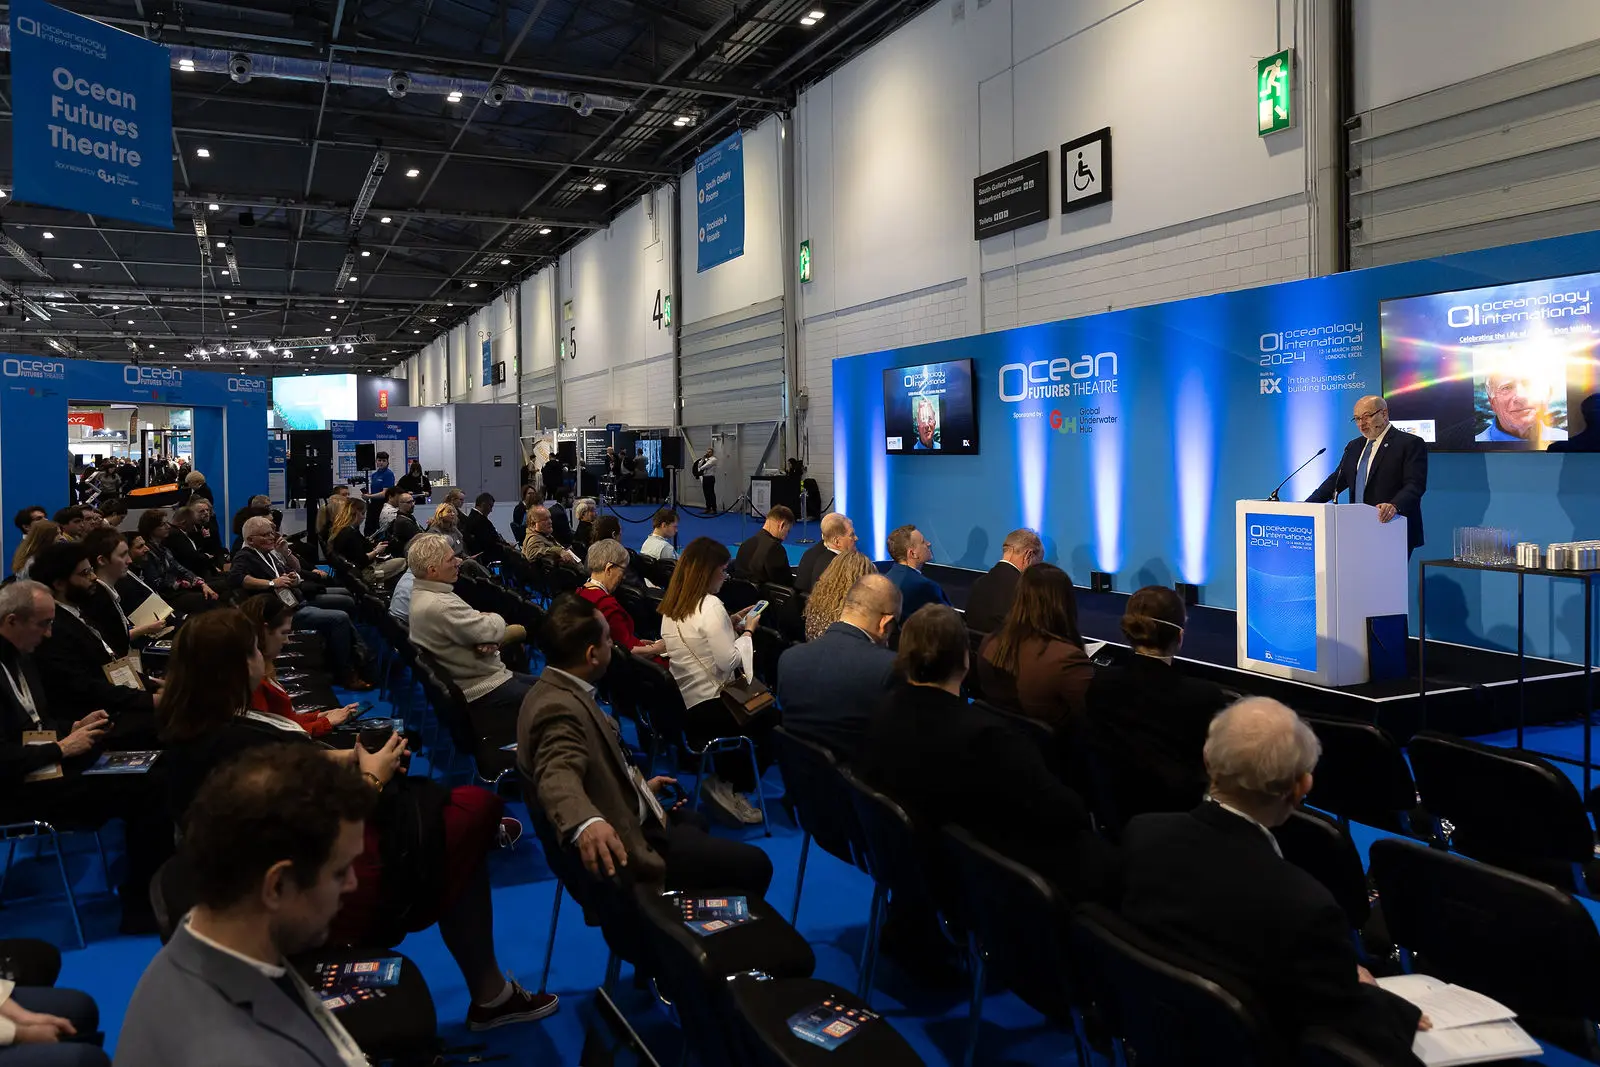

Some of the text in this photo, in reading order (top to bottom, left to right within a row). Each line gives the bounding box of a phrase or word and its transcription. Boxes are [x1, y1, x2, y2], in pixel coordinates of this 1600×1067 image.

[41, 24, 107, 52] oceanology
[41, 32, 107, 60] international
[52, 68, 137, 111] Ocean
[51, 95, 139, 140] Futures
[47, 125, 142, 167] Theatre
[1007, 175, 1024, 185] Rooms
[1002, 187, 1022, 197] Entrance
[979, 217, 993, 225] Toilets
[1481, 290, 1590, 312] oceanology
[652, 290, 663, 331] 4
[1481, 302, 1591, 326] international
[1285, 322, 1363, 339] oceanology
[1459, 333, 1495, 344] Celebrating
[1495, 332, 1506, 340] the
[570, 327, 577, 360] 5
[1284, 333, 1363, 350] international
[3, 359, 65, 377] Ocean
[1260, 352, 1306, 367] 2024
[123, 365, 182, 385] Ocean
[998, 352, 1118, 403] Ocean
[1287, 372, 1356, 385] In the business of
[227, 378, 266, 392] Ocean
[1027, 380, 1118, 400] FUTURES THEATRE
[1259, 378, 1283, 395] RX
[1287, 382, 1366, 393] building businesses
[1012, 411, 1035, 419] Sponsored
[1079, 407, 1101, 416] Global
[1079, 416, 1118, 425] Underwater
[1079, 426, 1093, 434] Hub
[1265, 526, 1312, 535] oceanology
[1265, 532, 1313, 541] international
[1250, 538, 1279, 547] 2024
